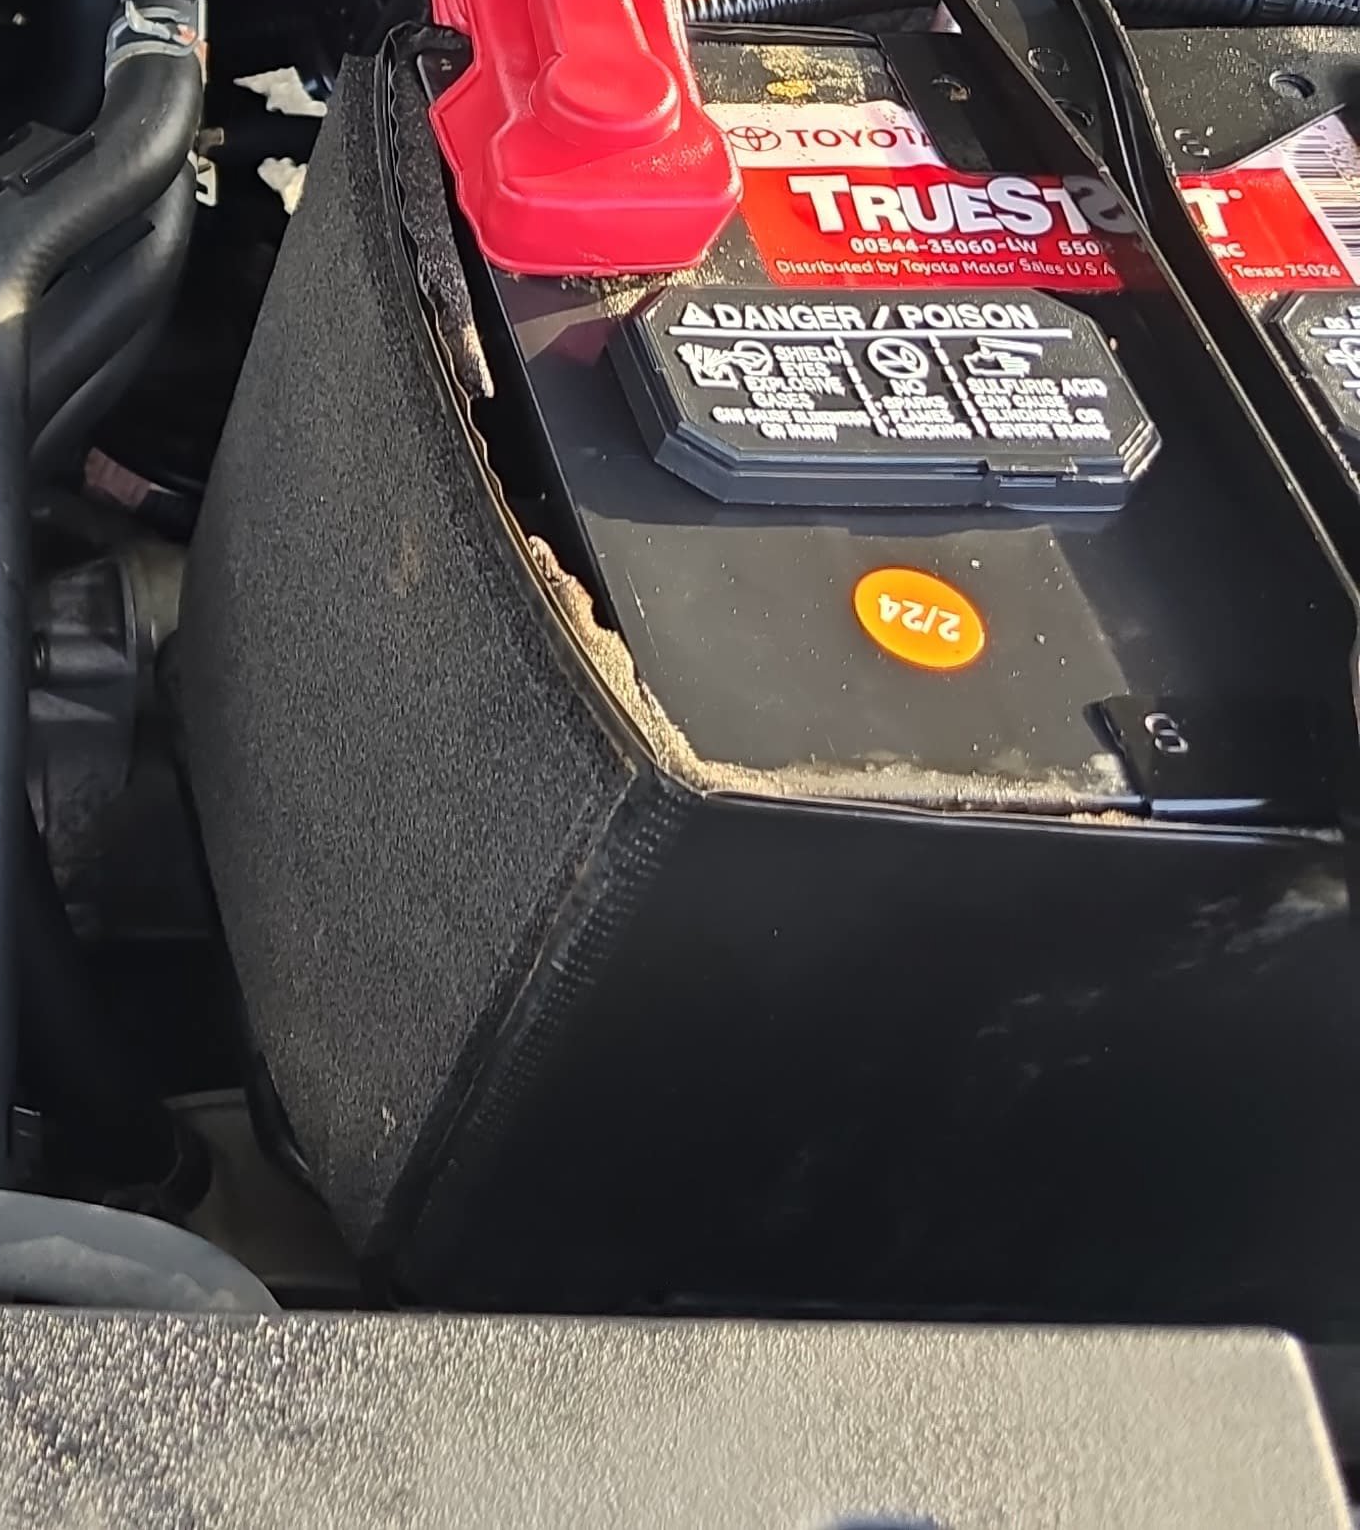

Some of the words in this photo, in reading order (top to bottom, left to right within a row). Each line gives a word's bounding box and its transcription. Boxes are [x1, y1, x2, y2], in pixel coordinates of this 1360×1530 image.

[775, 258, 874, 276] Distributed
[876, 258, 899, 276] by
[900, 258, 959, 277] Toyota
[961, 258, 1014, 276] Motor
[1017, 257, 1065, 276] Sales
[1233, 264, 1284, 278] Texas
[1284, 263, 1341, 278] 75024
[712, 303, 866, 331] DANGER
[896, 302, 1040, 330] POISON
[773, 344, 842, 365] SHIELD
[779, 362, 831, 378] EYES
[743, 375, 846, 397] EXPLOSIVE
[889, 378, 928, 397] NO
[965, 377, 1060, 396] SULFURIC
[1061, 378, 1108, 398] ACID
[751, 392, 816, 411] GASES
[974, 394, 1012, 410] CAN
[1012, 394, 1068, 411] CAUSE
[1075, 408, 1105, 425] OR
[878, 591, 962, 643] 2/24
